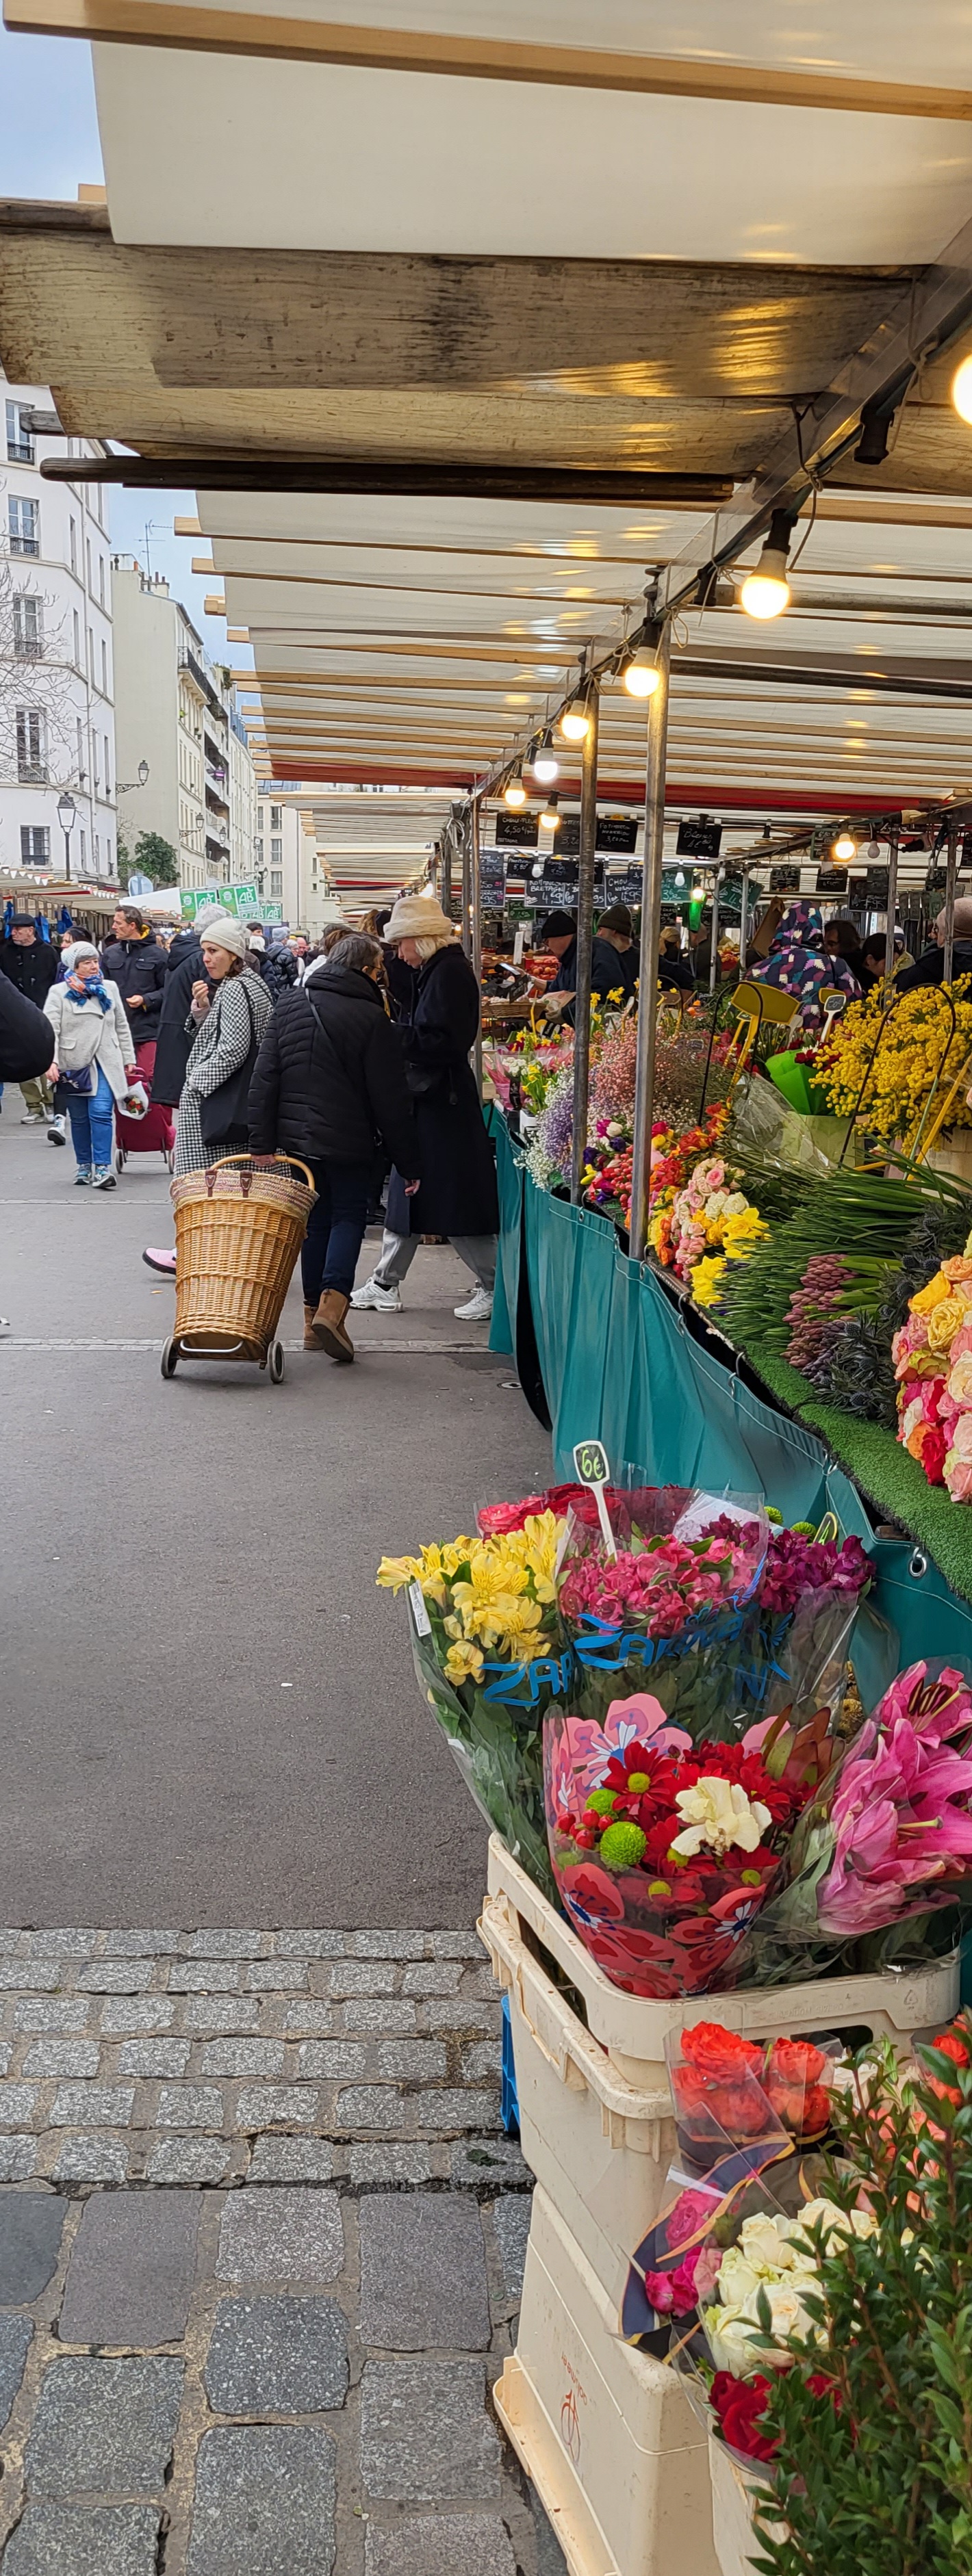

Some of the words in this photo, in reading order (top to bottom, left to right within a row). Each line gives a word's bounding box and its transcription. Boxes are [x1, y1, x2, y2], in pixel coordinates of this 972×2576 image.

[608, 879, 628, 887] CHOU
[239, 892, 254, 904] AB
[267, 910, 279, 919] AB
[582, 1449, 603, 1479] 6€
